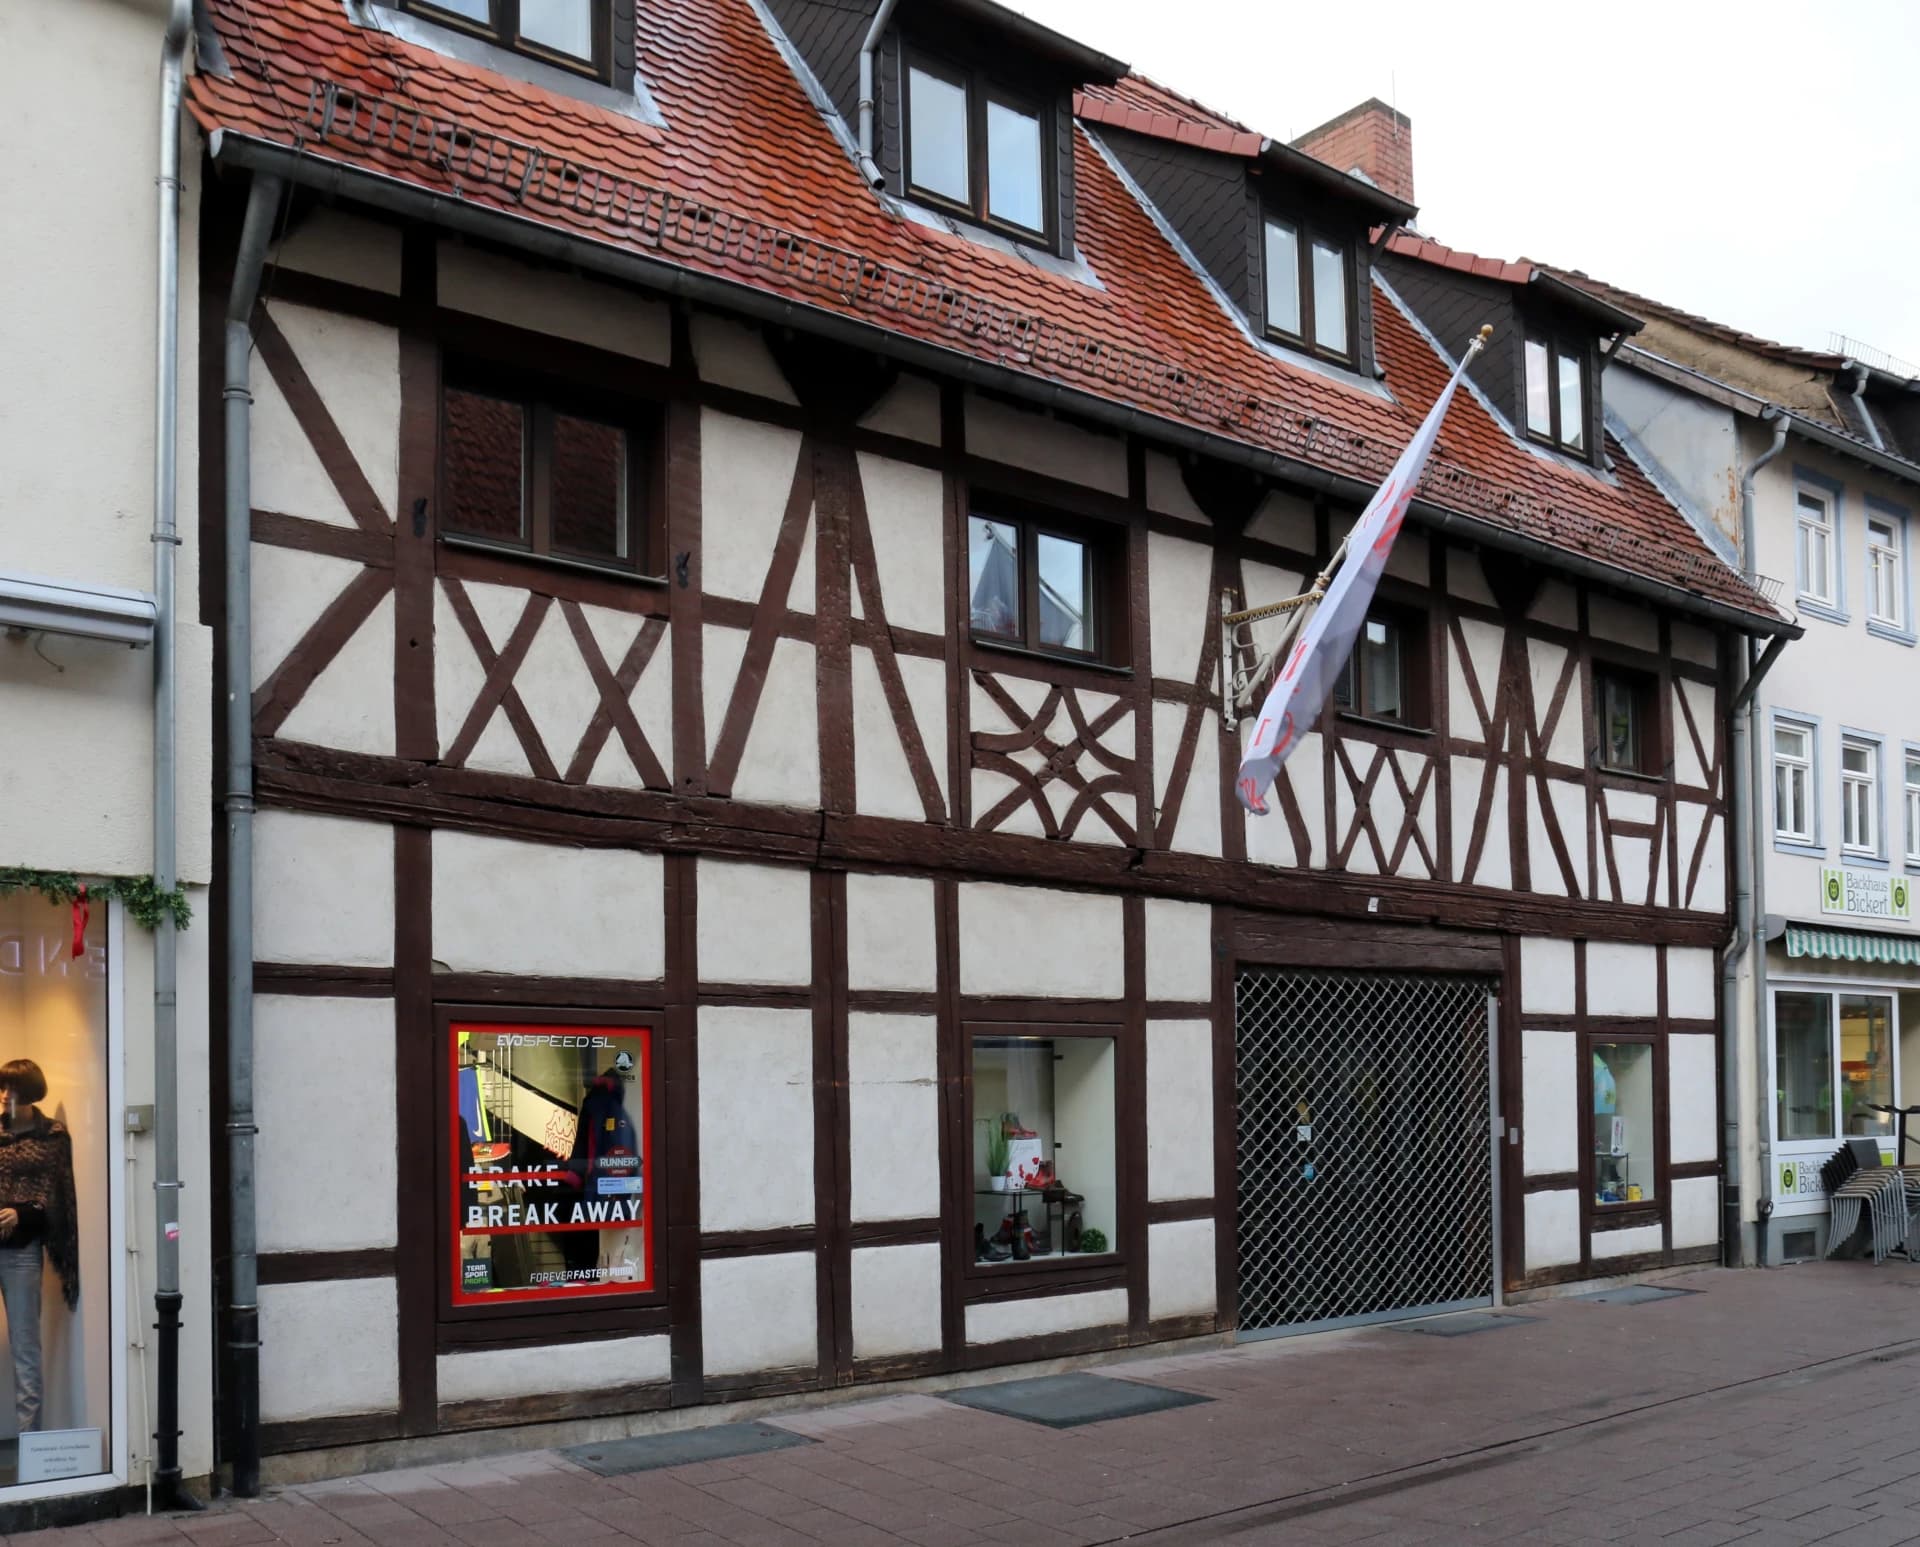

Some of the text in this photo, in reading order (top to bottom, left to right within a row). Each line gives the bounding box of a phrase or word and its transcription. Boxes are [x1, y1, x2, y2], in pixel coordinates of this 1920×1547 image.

[1846, 872, 1888, 892] Backhaus
[1847, 890, 1888, 915] Bickert
[591, 1036, 616, 1048] SL
[468, 1164, 559, 1189] BRAKE
[467, 1200, 641, 1227] BREAK AWAY
